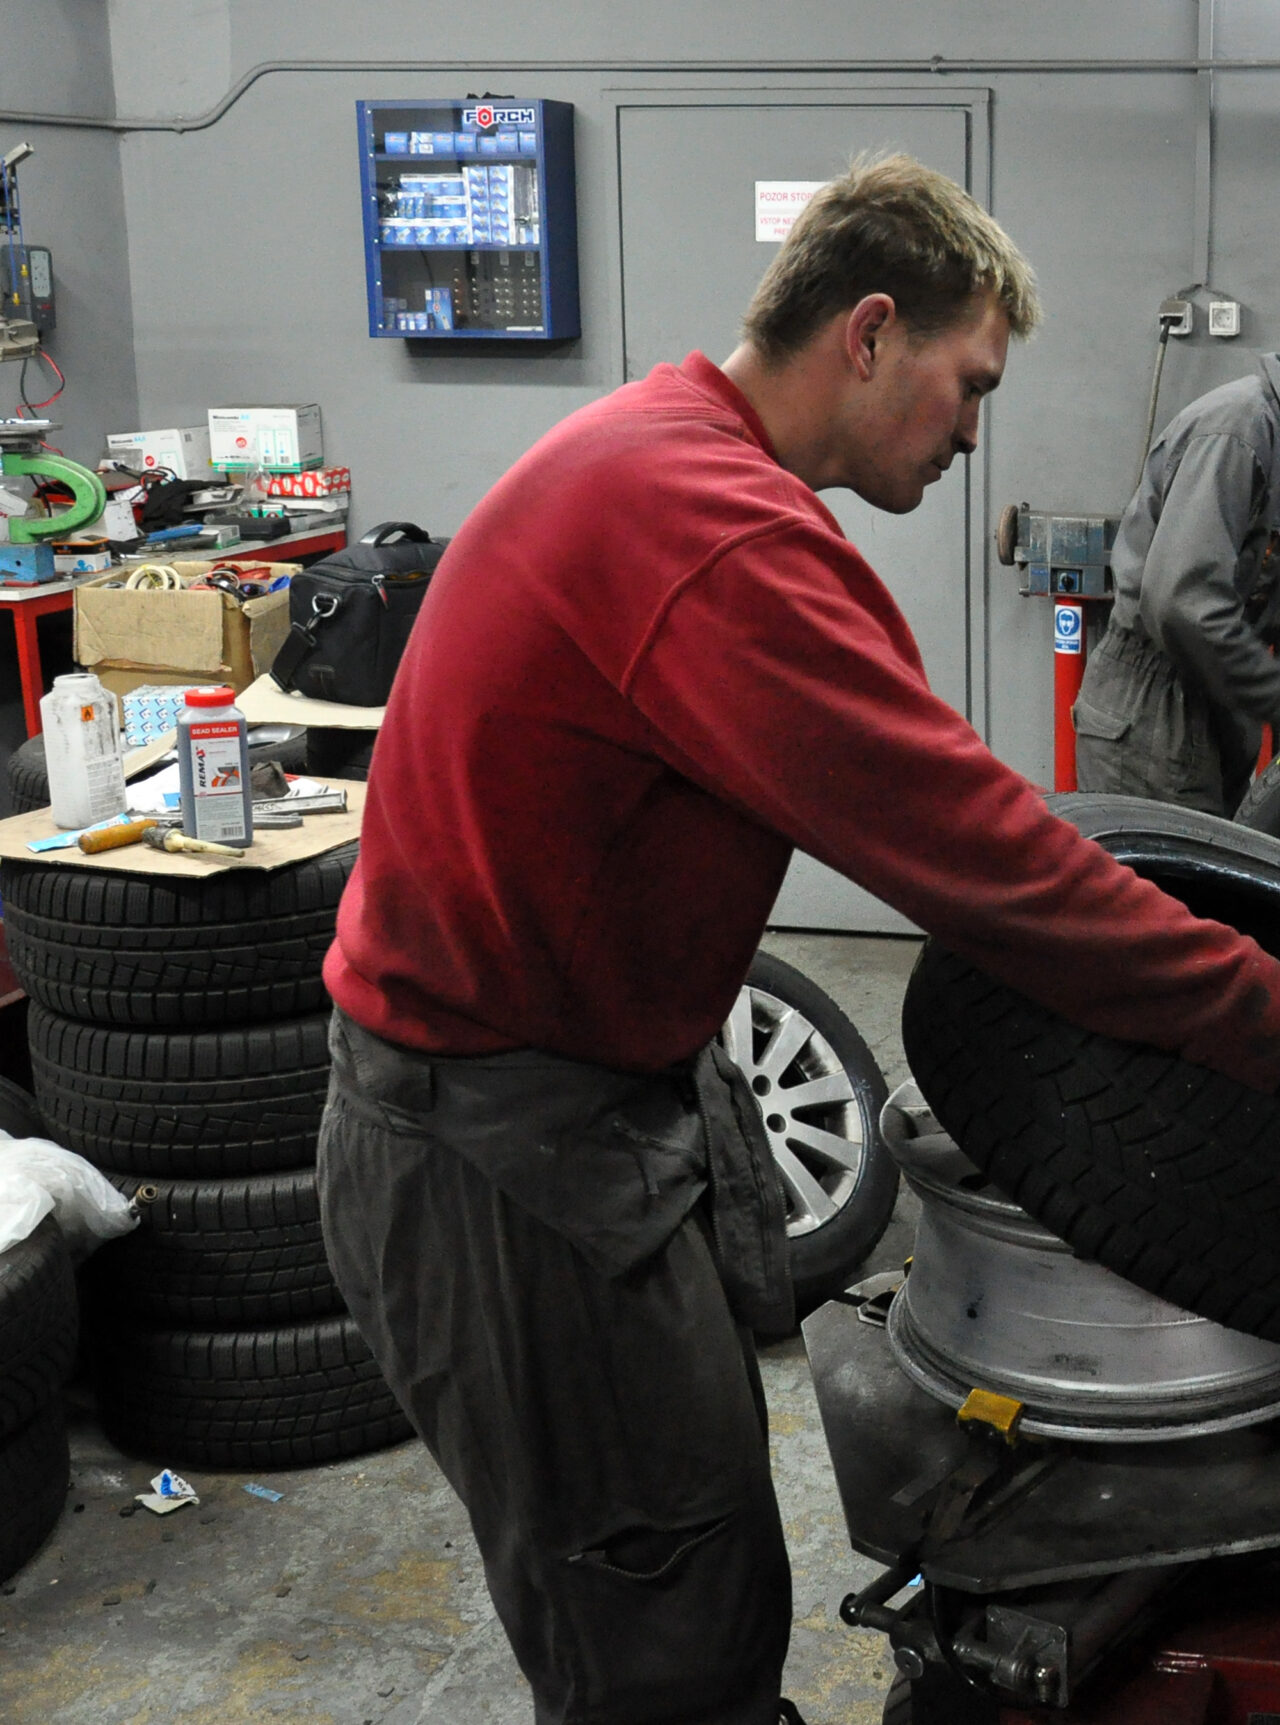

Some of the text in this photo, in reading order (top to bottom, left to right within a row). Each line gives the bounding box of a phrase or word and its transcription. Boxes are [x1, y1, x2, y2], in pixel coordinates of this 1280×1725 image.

[760, 192, 813, 201] POZOR STOP
[212, 726, 238, 734] SEALER
